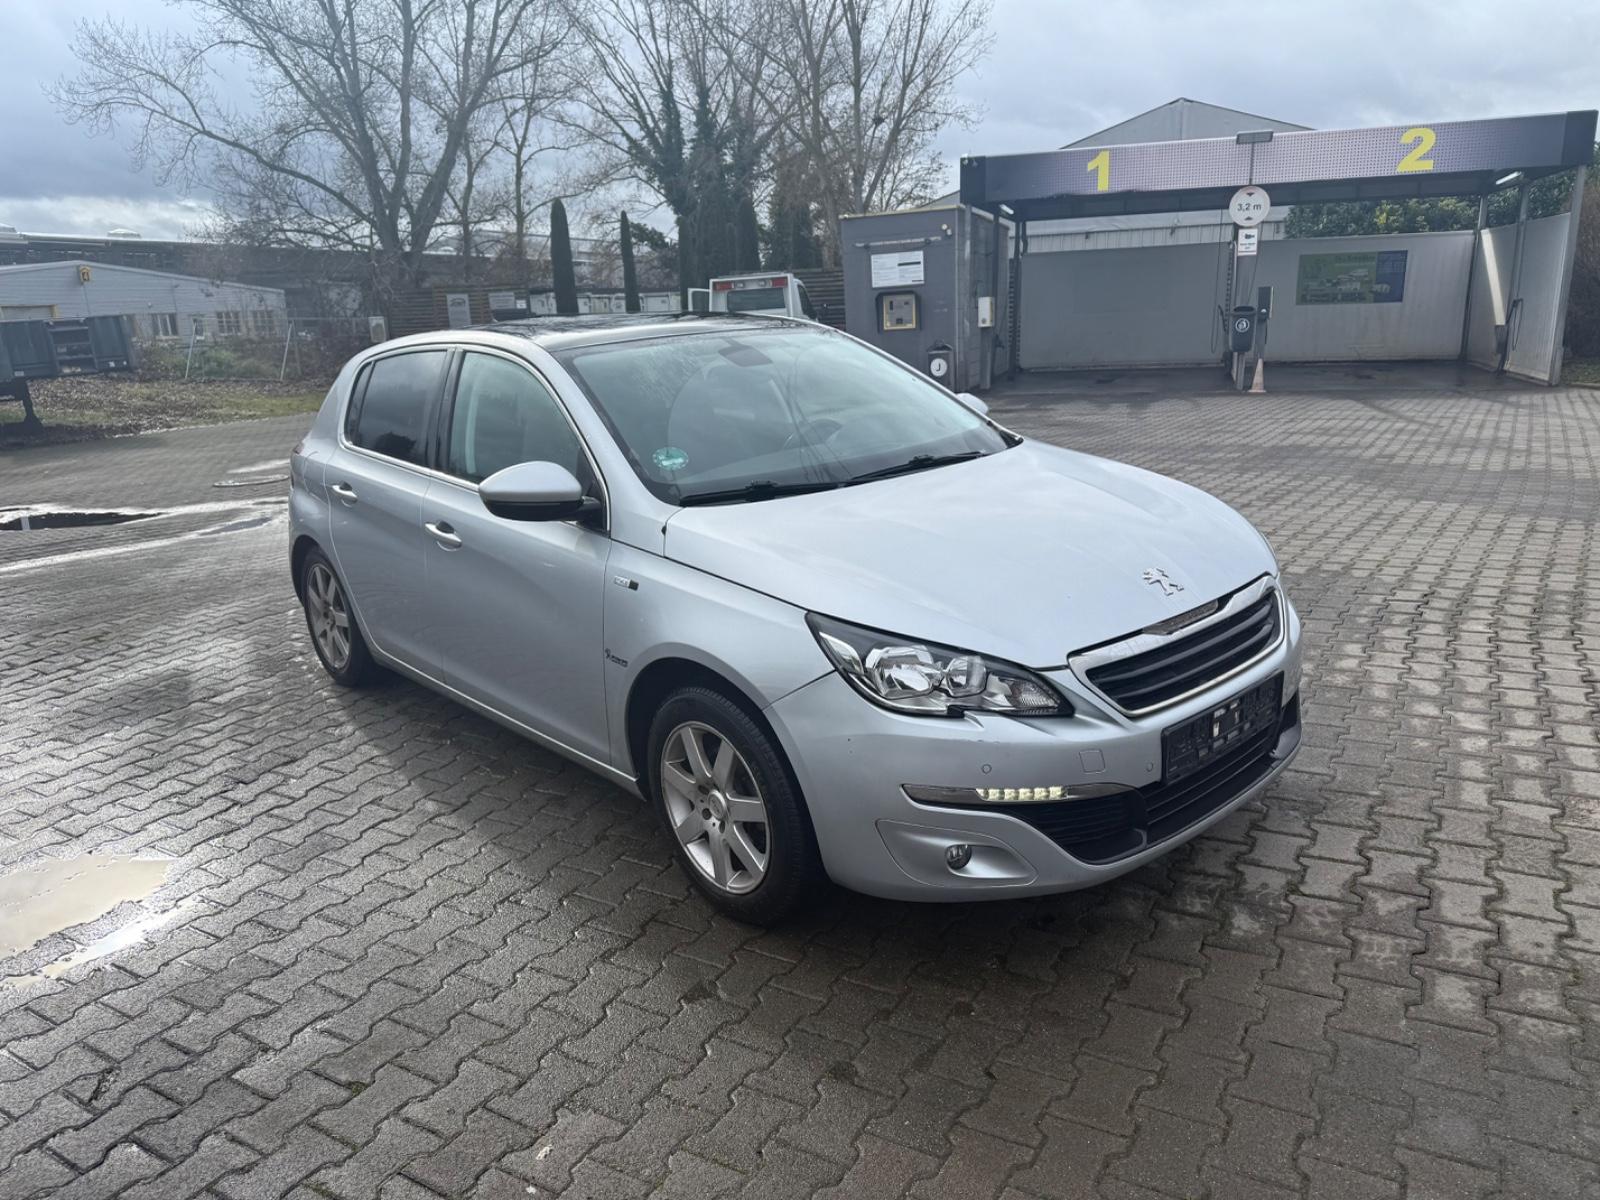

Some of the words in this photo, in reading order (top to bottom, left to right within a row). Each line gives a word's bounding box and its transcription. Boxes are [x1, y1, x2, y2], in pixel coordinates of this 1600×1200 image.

[1397, 128, 1435, 171] 2
[1088, 150, 1109, 192] 1
[1237, 203, 1251, 212] 3,2
